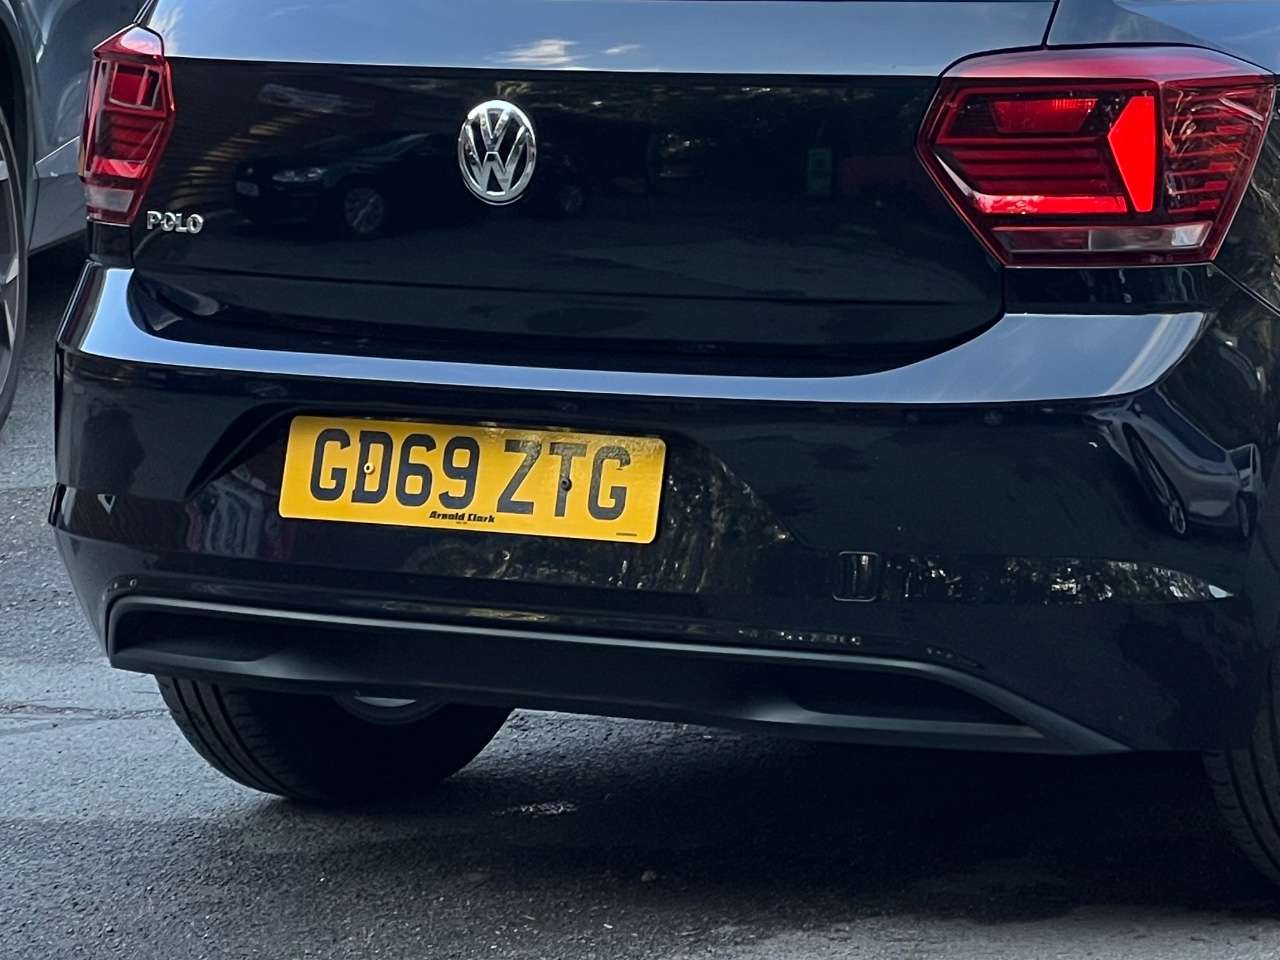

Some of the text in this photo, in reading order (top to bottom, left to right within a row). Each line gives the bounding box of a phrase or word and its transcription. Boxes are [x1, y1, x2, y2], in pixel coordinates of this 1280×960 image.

[147, 210, 204, 234] POLO
[309, 428, 632, 520] GD69 ZTG
[429, 511, 466, 521] Arnold
[467, 514, 495, 523] Clark
